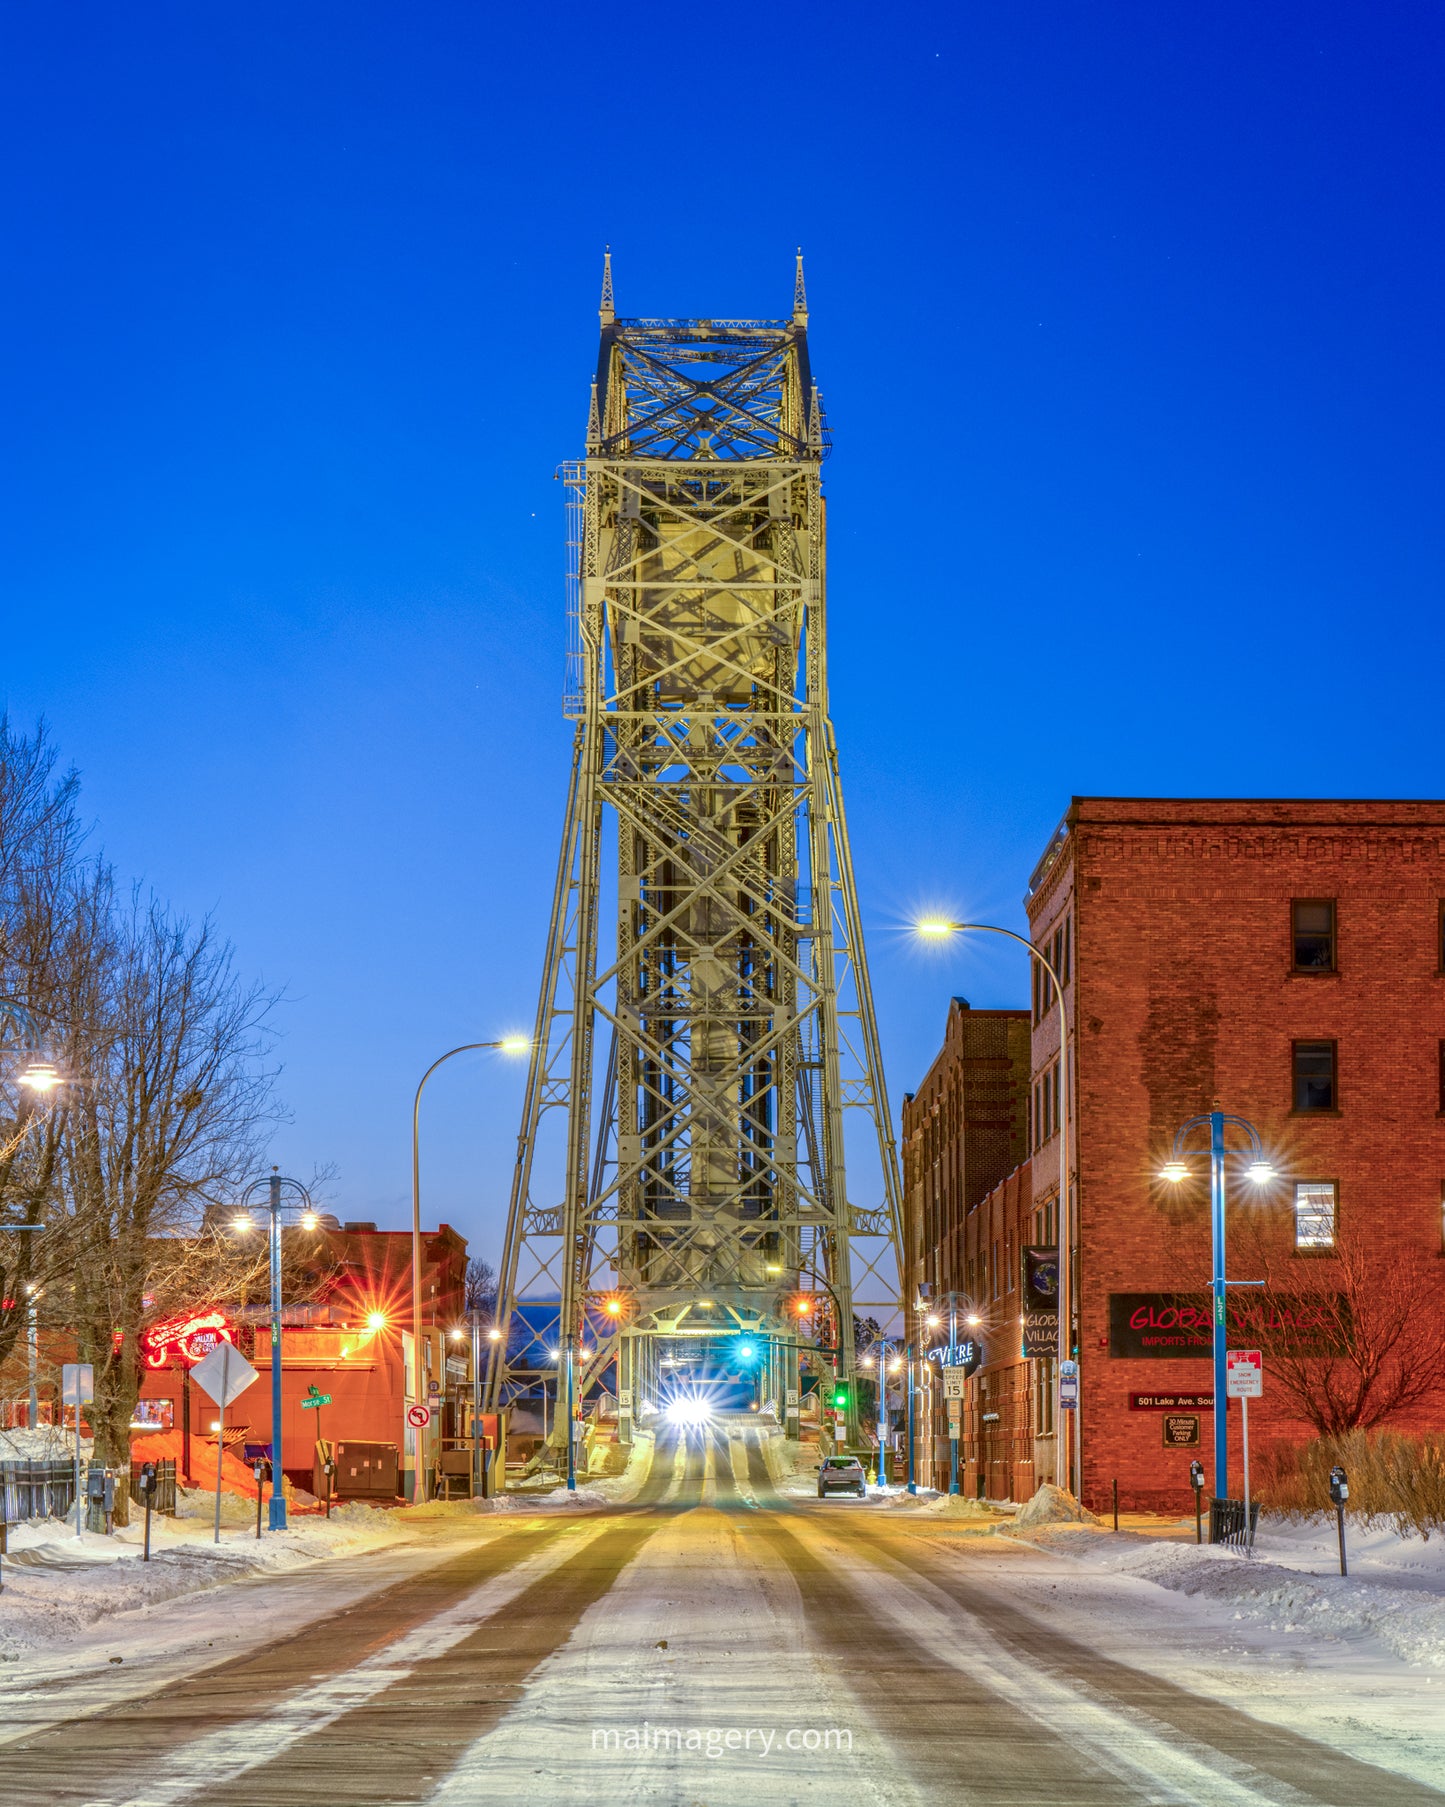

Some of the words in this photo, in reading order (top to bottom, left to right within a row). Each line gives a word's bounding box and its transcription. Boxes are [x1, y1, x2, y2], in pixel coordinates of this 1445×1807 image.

[1026, 1314, 1059, 1327] GLOB
[1129, 1306, 1213, 1329] GLOBA
[1026, 1330, 1059, 1342] VILLAG
[1141, 1336, 1186, 1346] IMPORTS
[947, 1386, 960, 1396] 15
[1138, 1397, 1153, 1405] 501
[1154, 1397, 1175, 1405] Lake
[1177, 1397, 1195, 1405] Ave.
[1197, 1397, 1215, 1405] Sou
